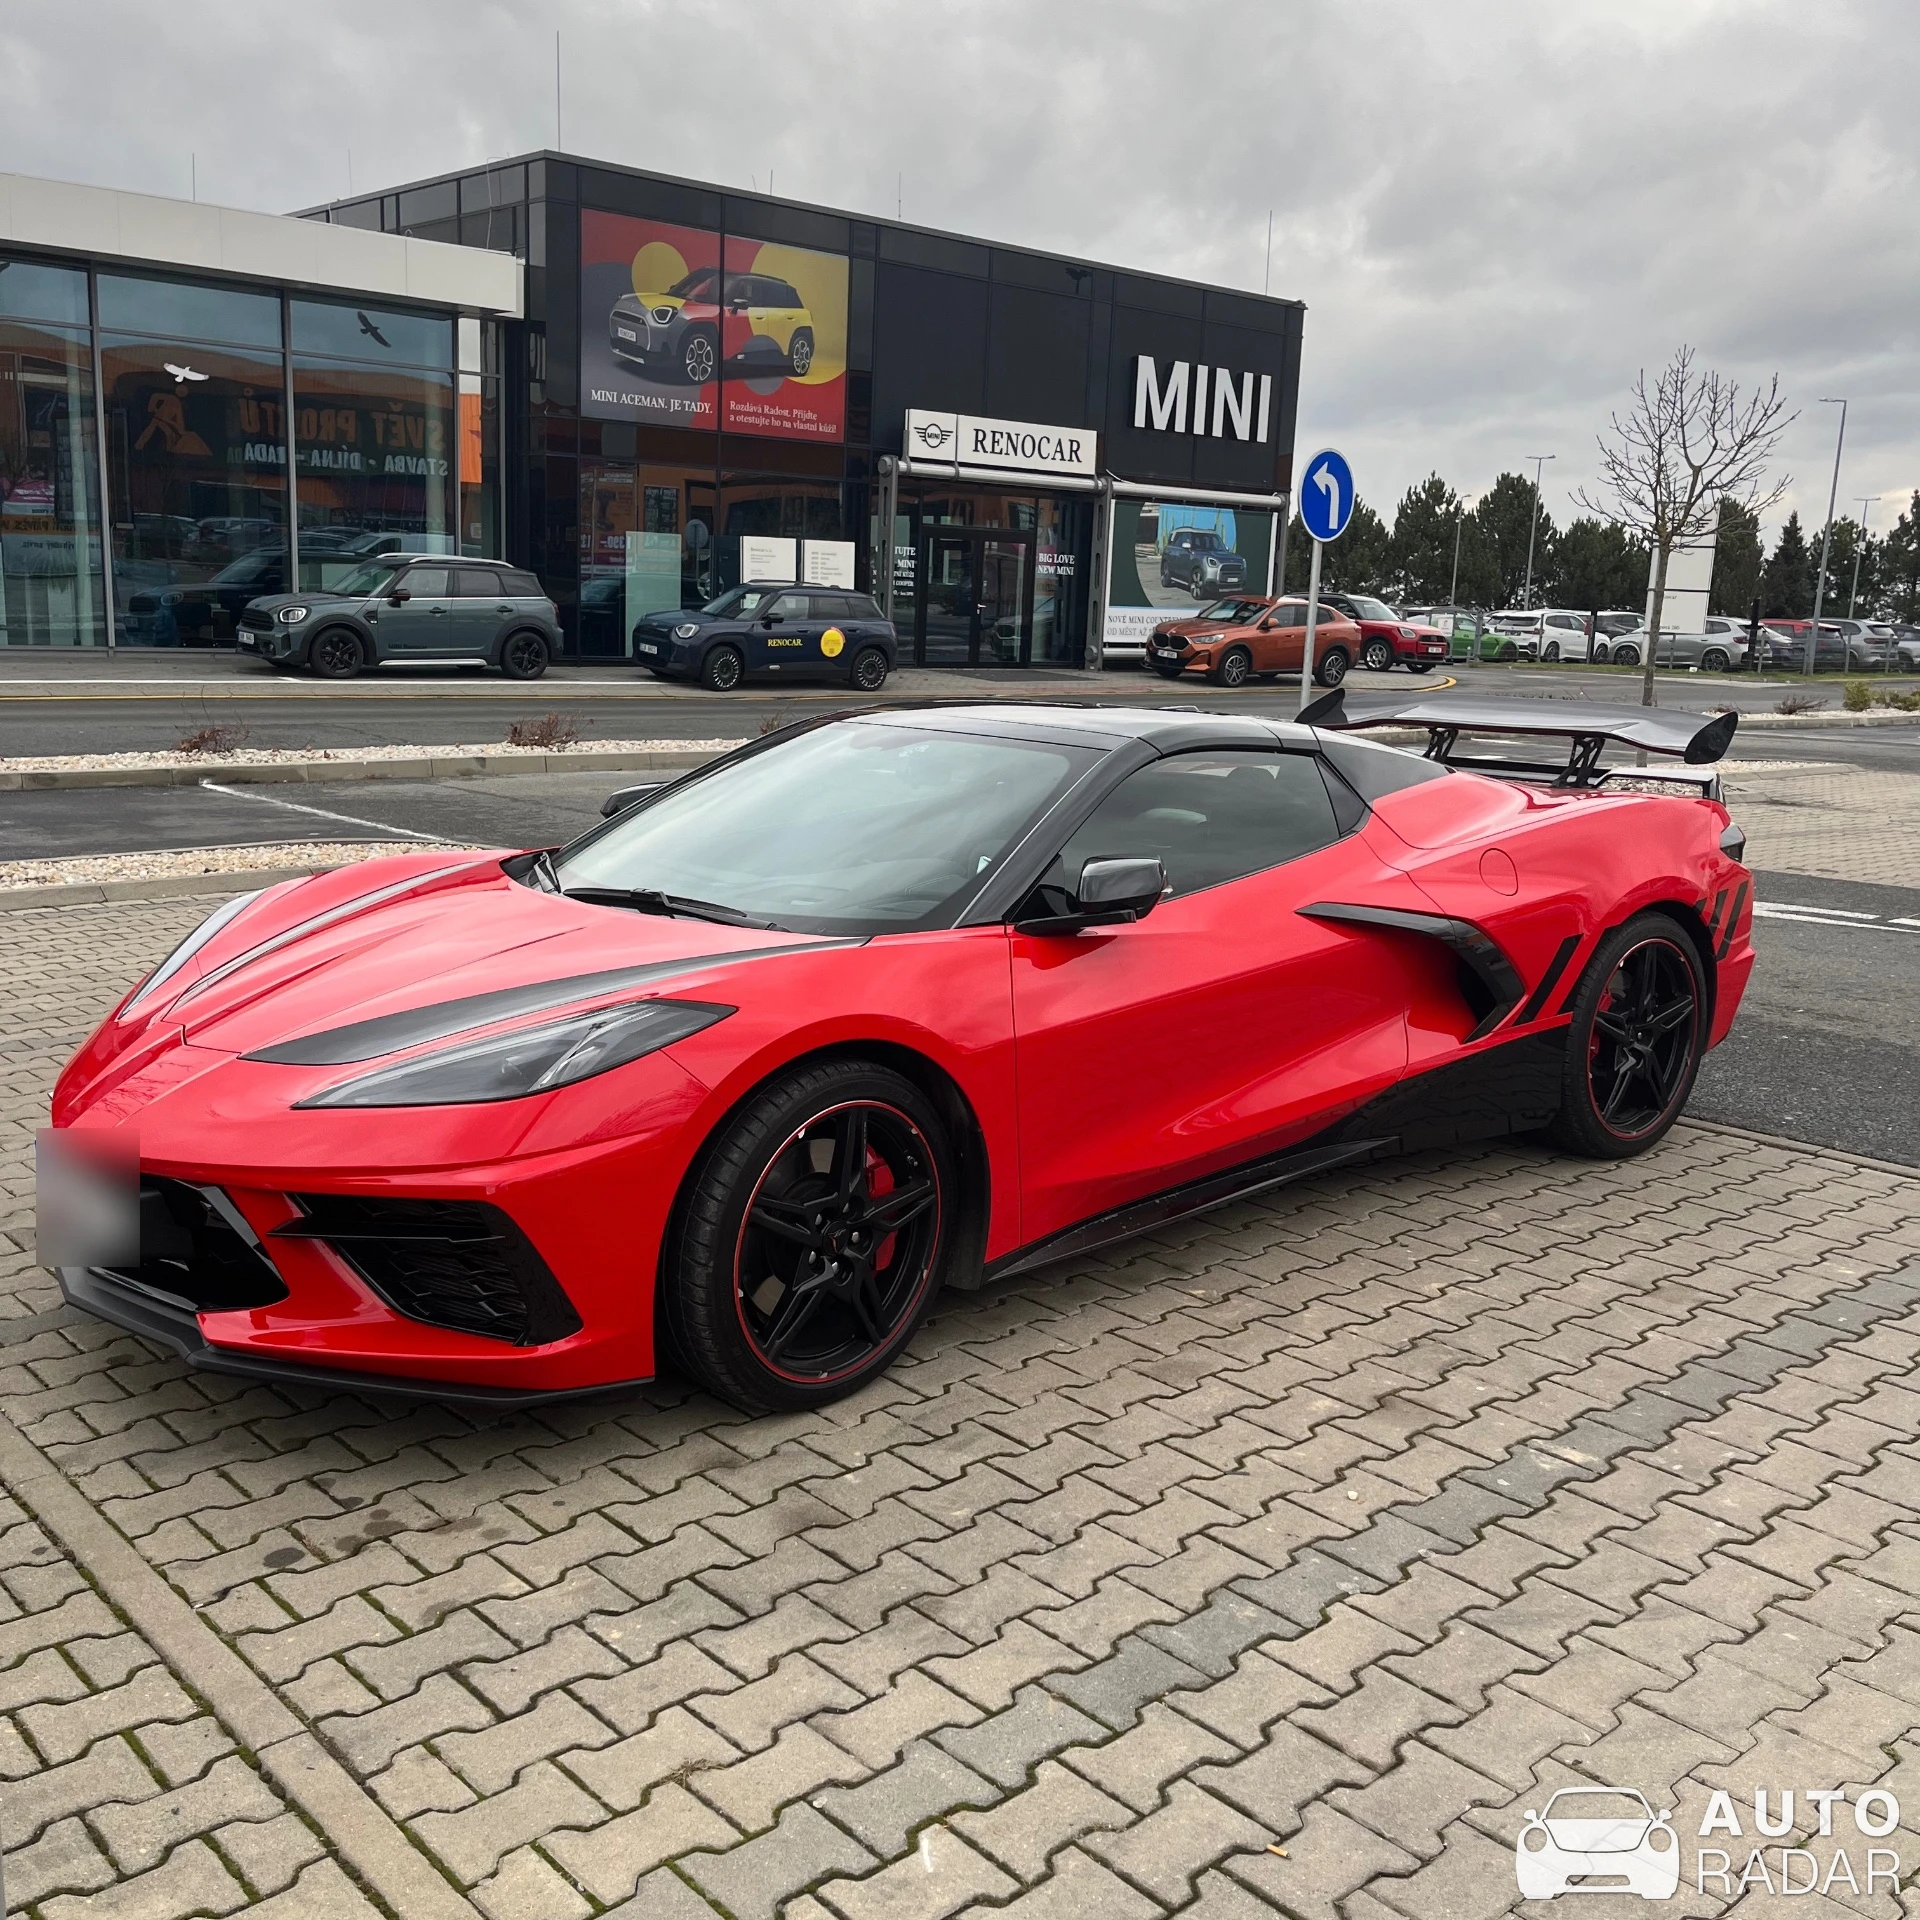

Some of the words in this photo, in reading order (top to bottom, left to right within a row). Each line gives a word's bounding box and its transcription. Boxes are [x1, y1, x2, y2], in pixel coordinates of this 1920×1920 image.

[591, 389, 618, 403] MINI
[619, 393, 668, 409] ACEMAN.
[669, 398, 681, 412] JE
[683, 400, 713, 414] TADY.
[1134, 354, 1272, 443] MINI
[729, 400, 762, 414] Rozdává
[763, 404, 791, 418] Radost.
[729, 414, 735, 422] a
[736, 414, 770, 427] otestujte
[771, 416, 782, 427] ho
[782, 420, 792, 429] na
[793, 420, 818, 432] vlastní
[926, 432, 941, 440] MINI
[972, 428, 1083, 463] RENOCAR
[894, 546, 916, 557] TUJTE
[1038, 552, 1053, 563] BIG
[1053, 553, 1076, 565] LOVE
[1037, 564, 1056, 575] NEW
[1056, 565, 1074, 576] MINI
[1108, 615, 1127, 624] NOVÉ
[1128, 615, 1144, 624] MINI
[1107, 627, 1118, 636] OD
[1119, 626, 1137, 636] MĚST
